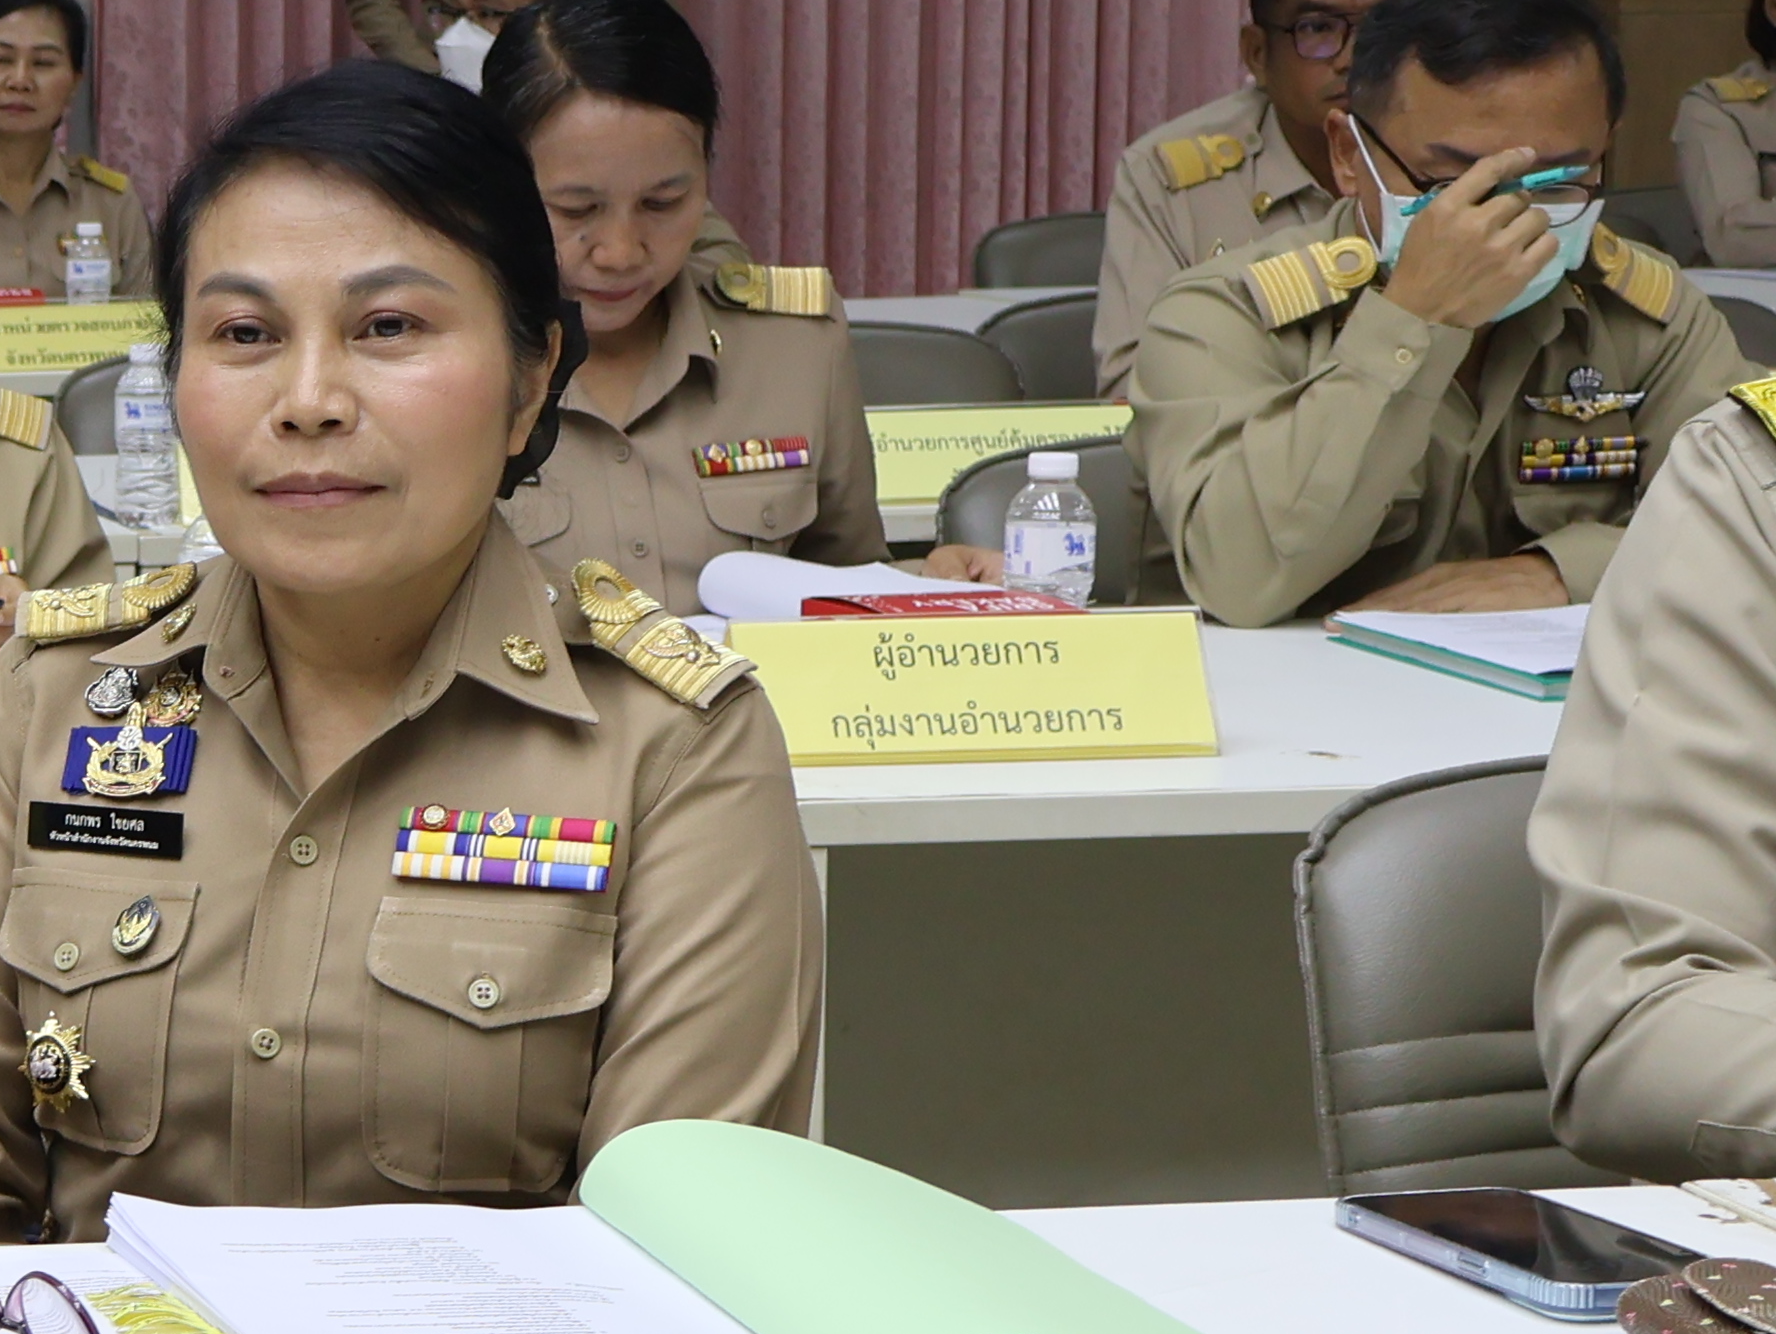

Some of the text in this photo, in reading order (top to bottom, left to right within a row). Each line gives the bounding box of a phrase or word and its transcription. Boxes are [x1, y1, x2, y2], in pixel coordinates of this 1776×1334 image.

[872, 632, 1061, 680] ผู้อำนวยการ
[831, 701, 1124, 750] กลุ่มงานอำนวยการ
